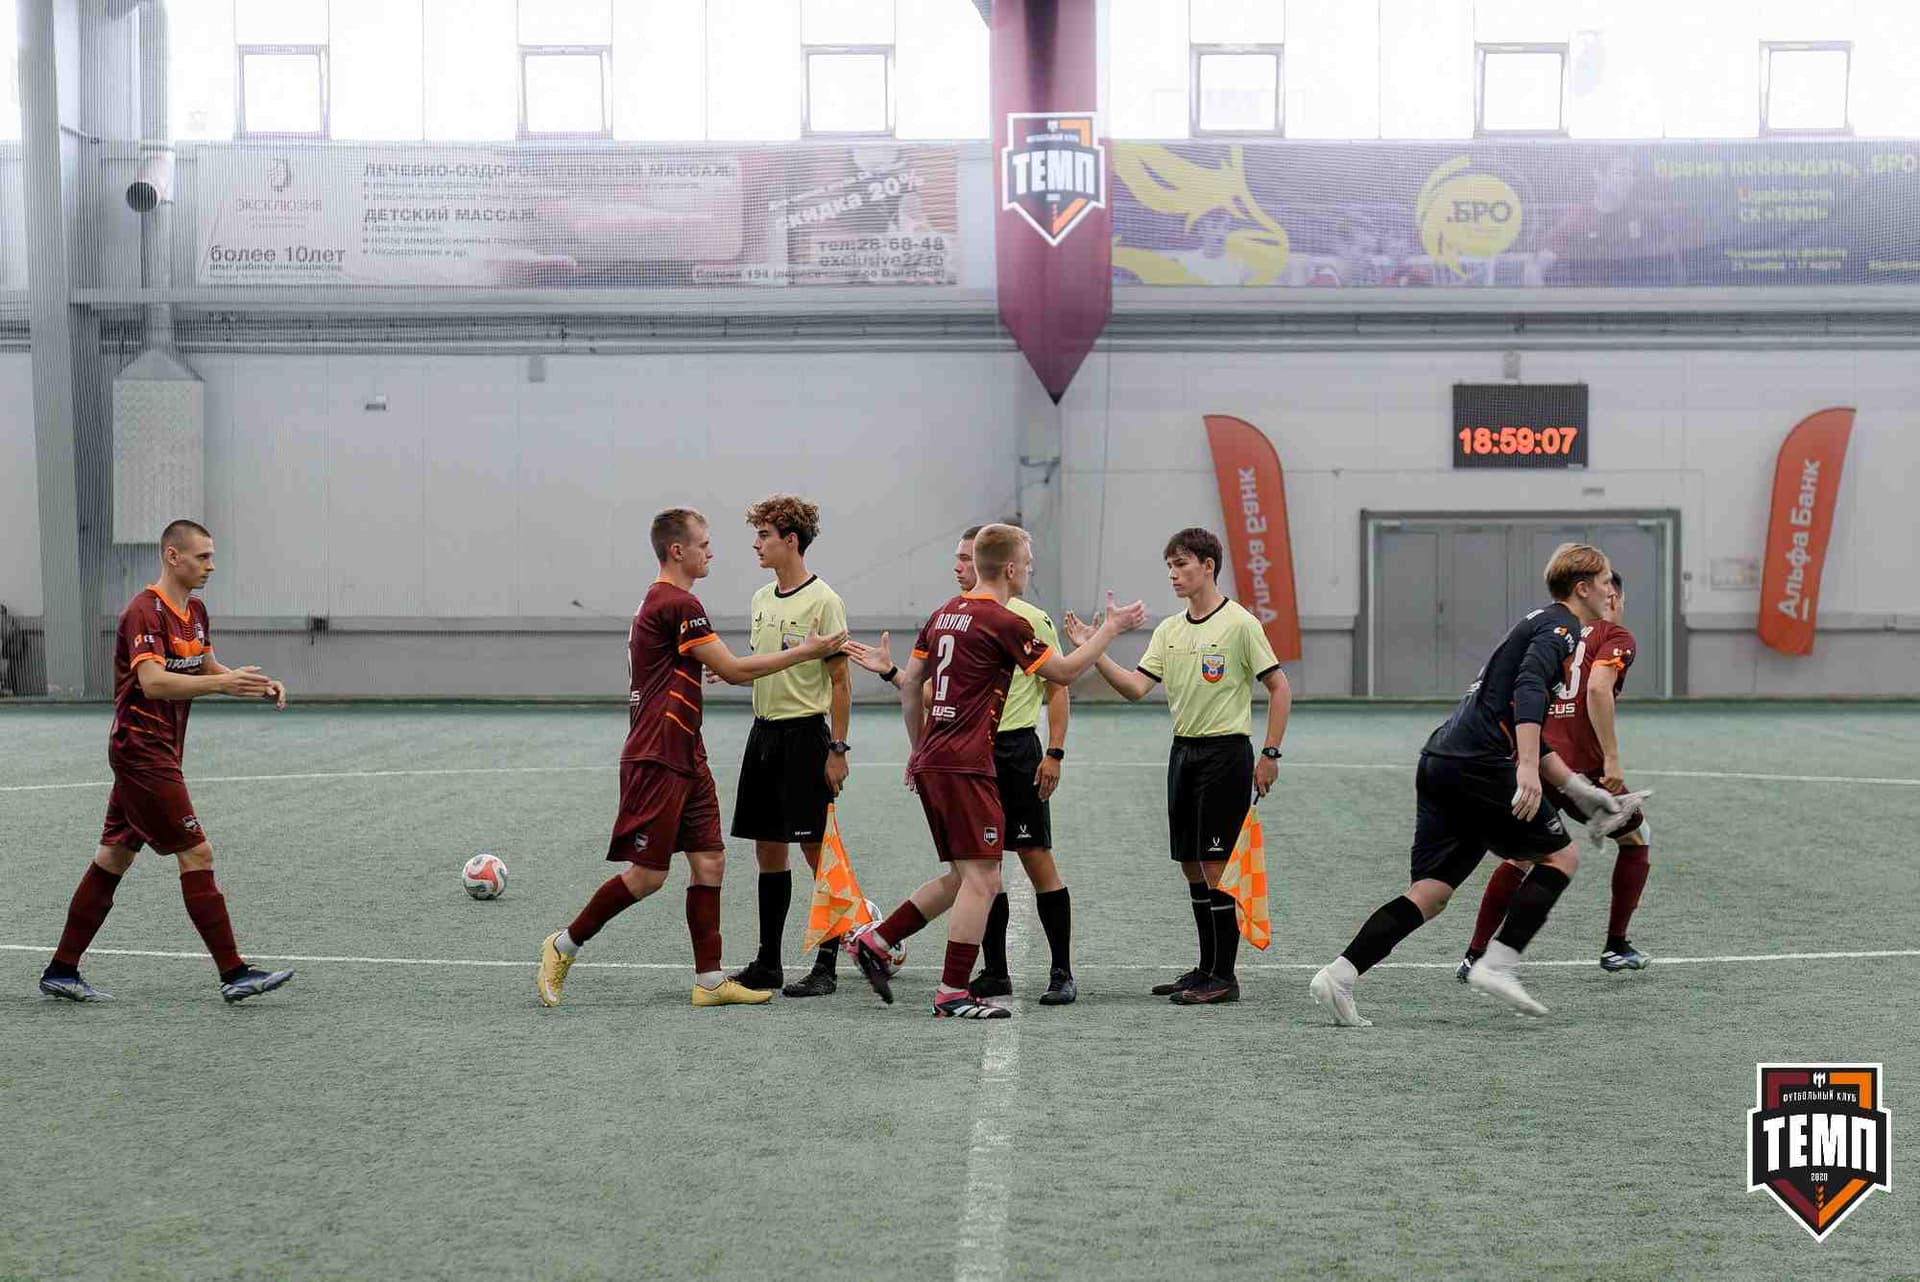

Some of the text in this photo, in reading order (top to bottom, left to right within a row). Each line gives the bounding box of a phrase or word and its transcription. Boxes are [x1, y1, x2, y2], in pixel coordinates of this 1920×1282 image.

[1011, 149, 1095, 195] ТЕМП
[362, 206, 449, 224] ДЕТСКИЙ
[210, 245, 276, 264] более
[1459, 427, 1578, 454] 18:59:07
[1777, 459, 1821, 619] Альфа Банк
[935, 634, 955, 701] 2
